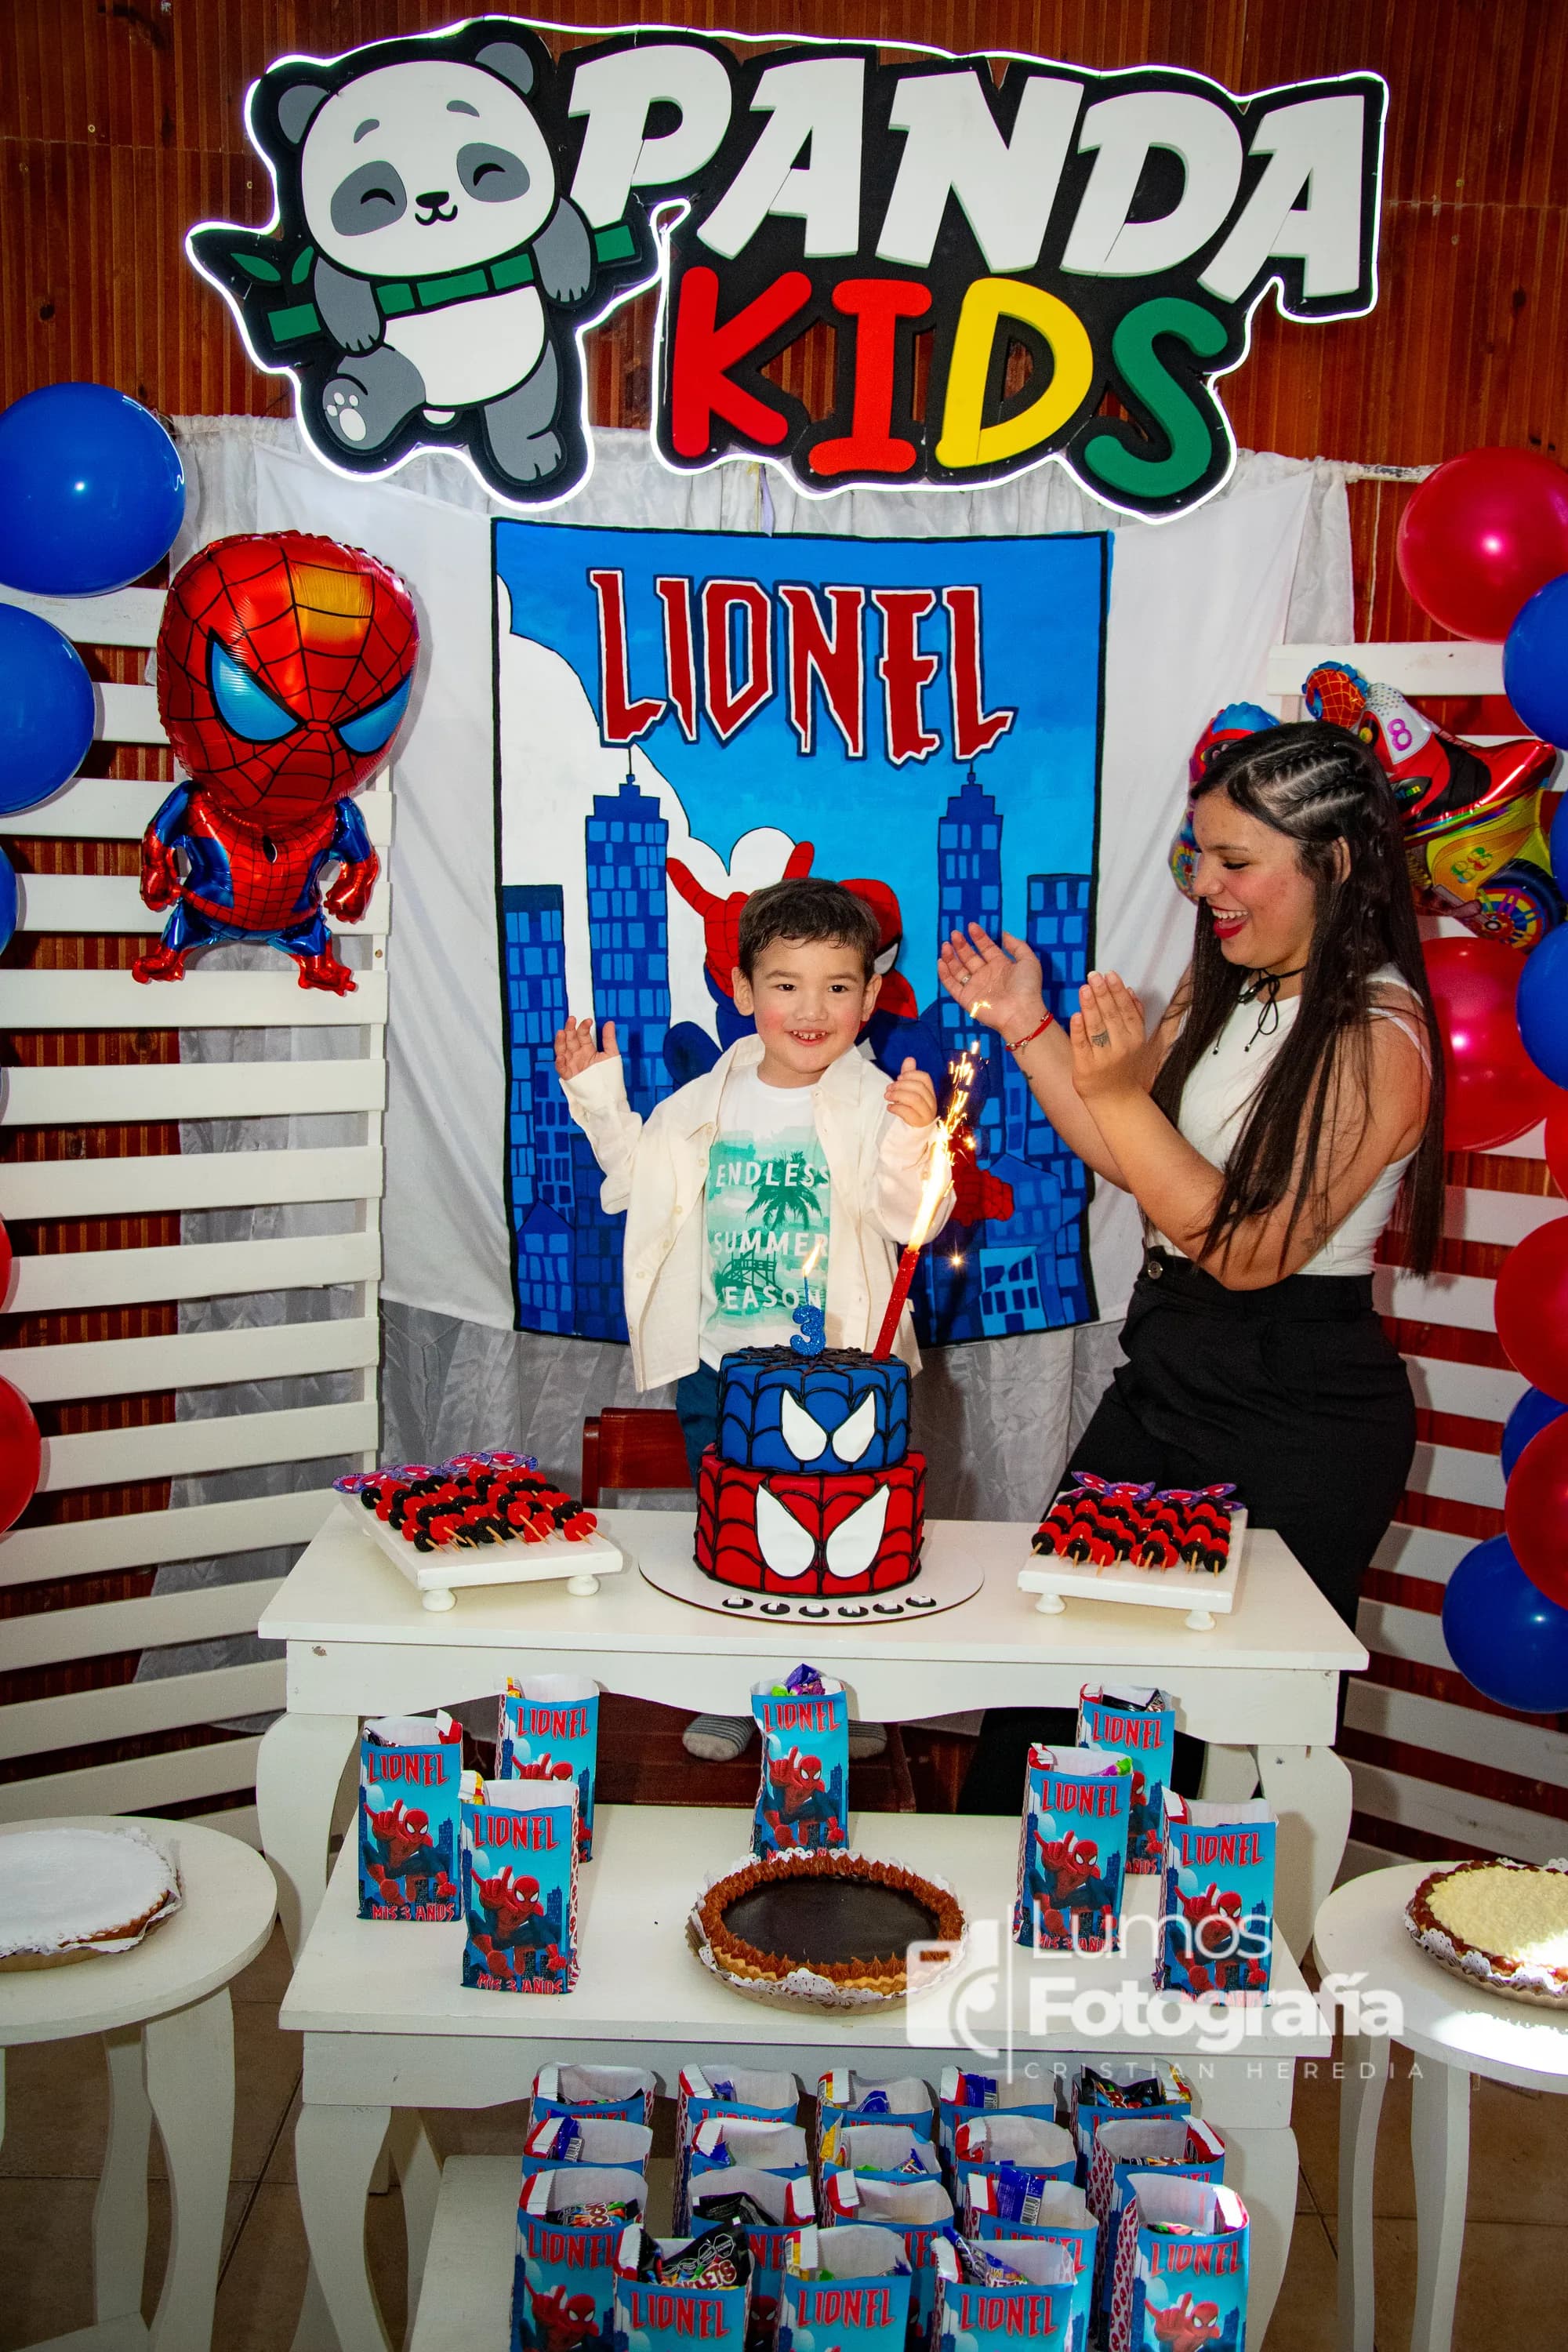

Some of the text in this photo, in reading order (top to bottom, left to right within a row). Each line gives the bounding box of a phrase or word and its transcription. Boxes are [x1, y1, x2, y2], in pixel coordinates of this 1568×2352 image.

[569, 45, 1364, 304] PANDA
[672, 267, 1229, 498] KIDS
[587, 567, 1016, 767] LIONEL
[1388, 718, 1413, 751] 8
[716, 1161, 829, 1189] ENDLESS
[714, 1229, 828, 1256] SUMMER
[724, 1285, 822, 1310] EASON
[790, 1305, 826, 1356] 3
[517, 1707, 590, 1740] LIONEL
[763, 1700, 841, 1733] LIONEL
[1092, 1711, 1165, 1750] LIONEL
[368, 1752, 449, 1788] LIONEL
[1040, 1779, 1123, 1818] LIONEL
[474, 1813, 560, 1852] LIONEL
[1181, 1832, 1264, 1867] LIONEL
[528, 2223, 615, 2270] LIONEL
[1149, 2240, 1243, 2278] LIONEL
[630, 2291, 730, 2340] LIONEL
[797, 2288, 895, 2329] LIONEL
[959, 2293, 1058, 2338] LIONEL
